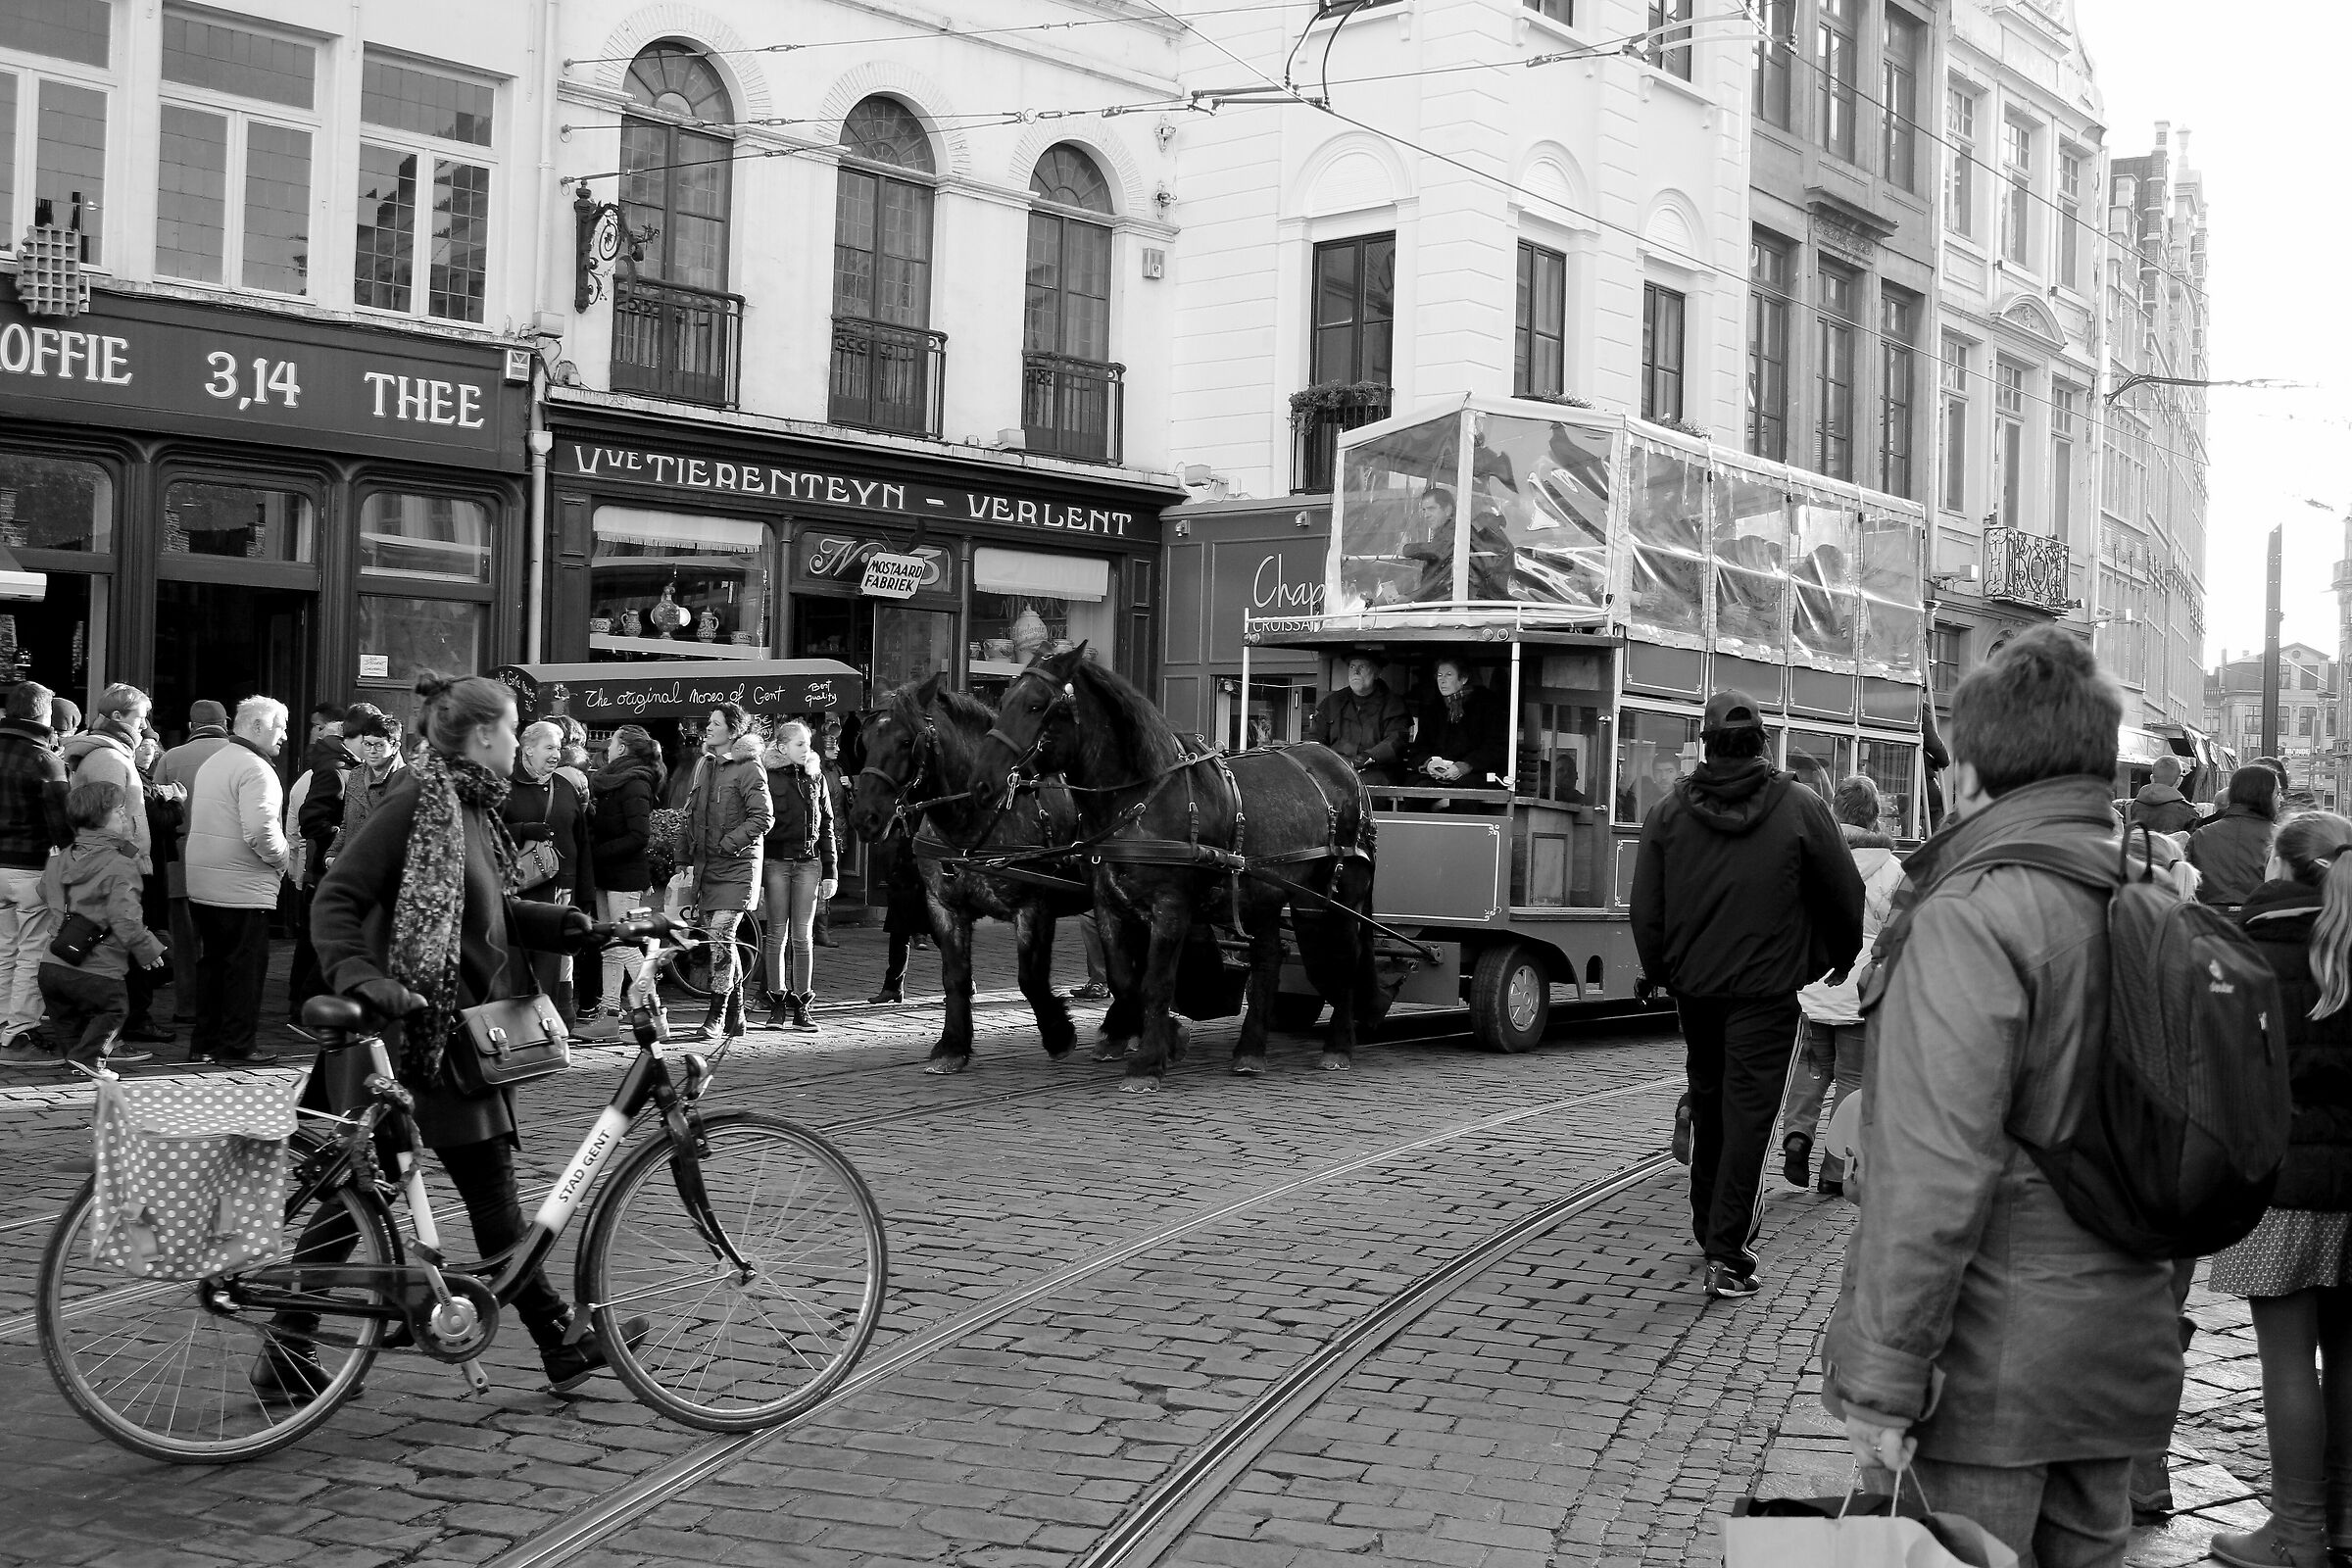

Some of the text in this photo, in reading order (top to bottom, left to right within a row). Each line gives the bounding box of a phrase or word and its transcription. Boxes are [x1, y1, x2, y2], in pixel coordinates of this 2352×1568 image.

[0, 322, 485, 429] OFFIE 3,14 THEE
[646, 453, 905, 510] TIERENTEYN
[966, 493, 1132, 535] VERLENT
[866, 560, 923, 578] MOSTAARD
[864, 574, 915, 593] FABRIEK
[585, 687, 612, 708] The
[616, 680, 683, 714] original
[729, 682, 745, 706] of
[753, 685, 786, 706] Gent
[808, 679, 833, 692] Best
[805, 691, 838, 708] quality
[559, 1129, 611, 1202] STAD GENT
